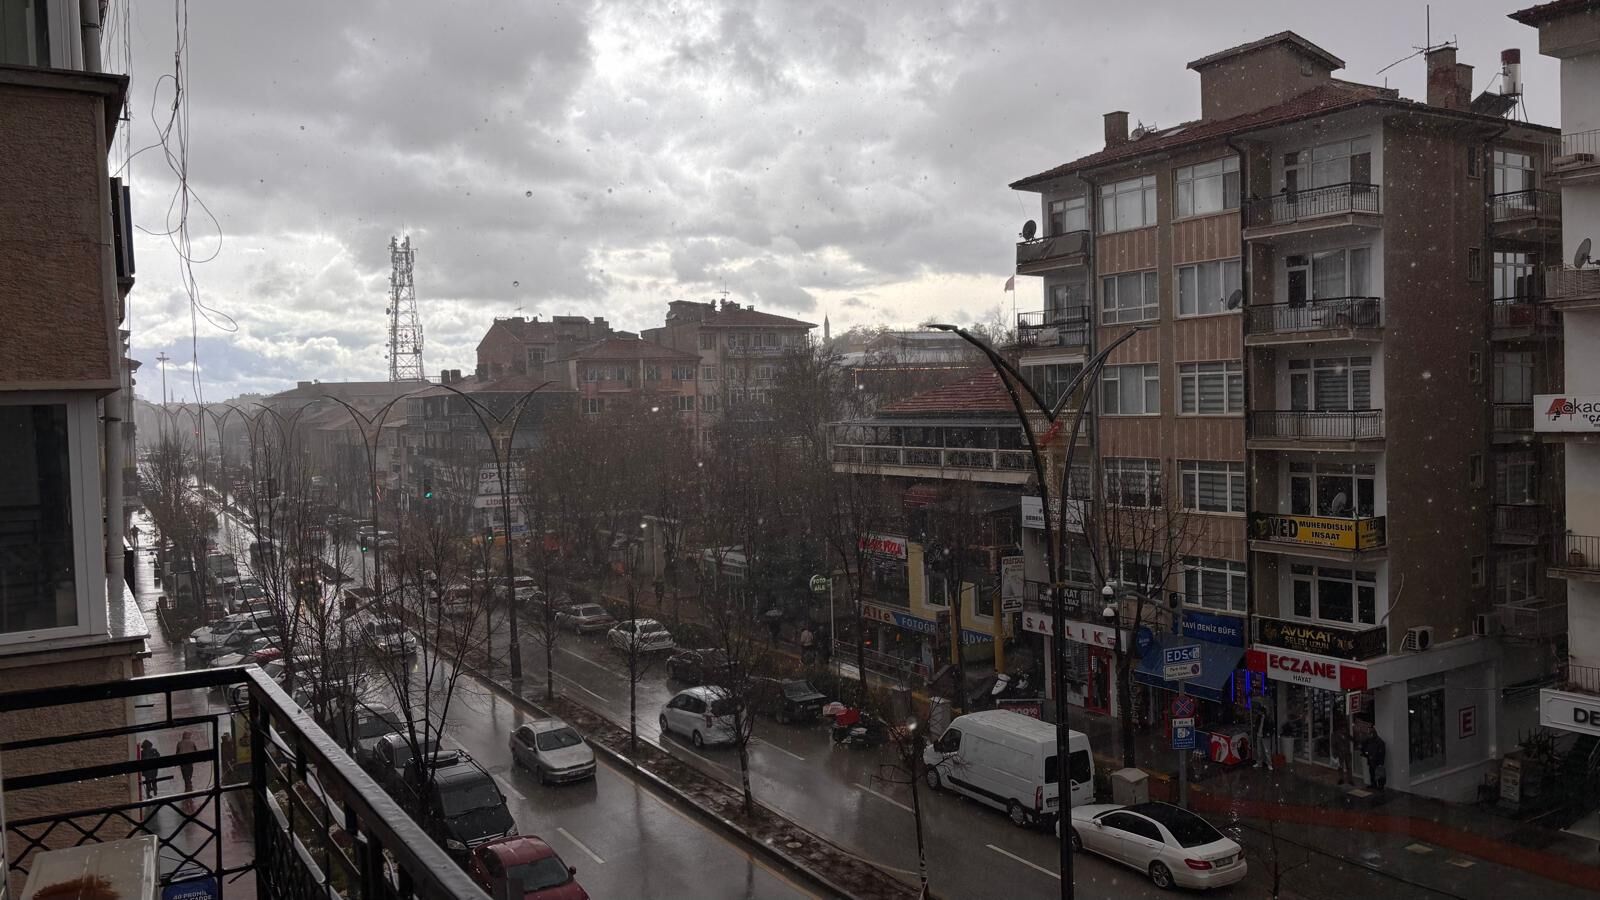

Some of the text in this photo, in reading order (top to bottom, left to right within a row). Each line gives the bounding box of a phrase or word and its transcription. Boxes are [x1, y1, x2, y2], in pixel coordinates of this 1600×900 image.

[1268, 517, 1299, 538] YED
[1026, 617, 1104, 645] SALIK
[1281, 626, 1334, 643] AVUKAT
[1167, 649, 1188, 661] EDS
[1269, 654, 1337, 680] ECZANE
[1293, 674, 1312, 684] HAYAT
[1463, 711, 1473, 733] E
